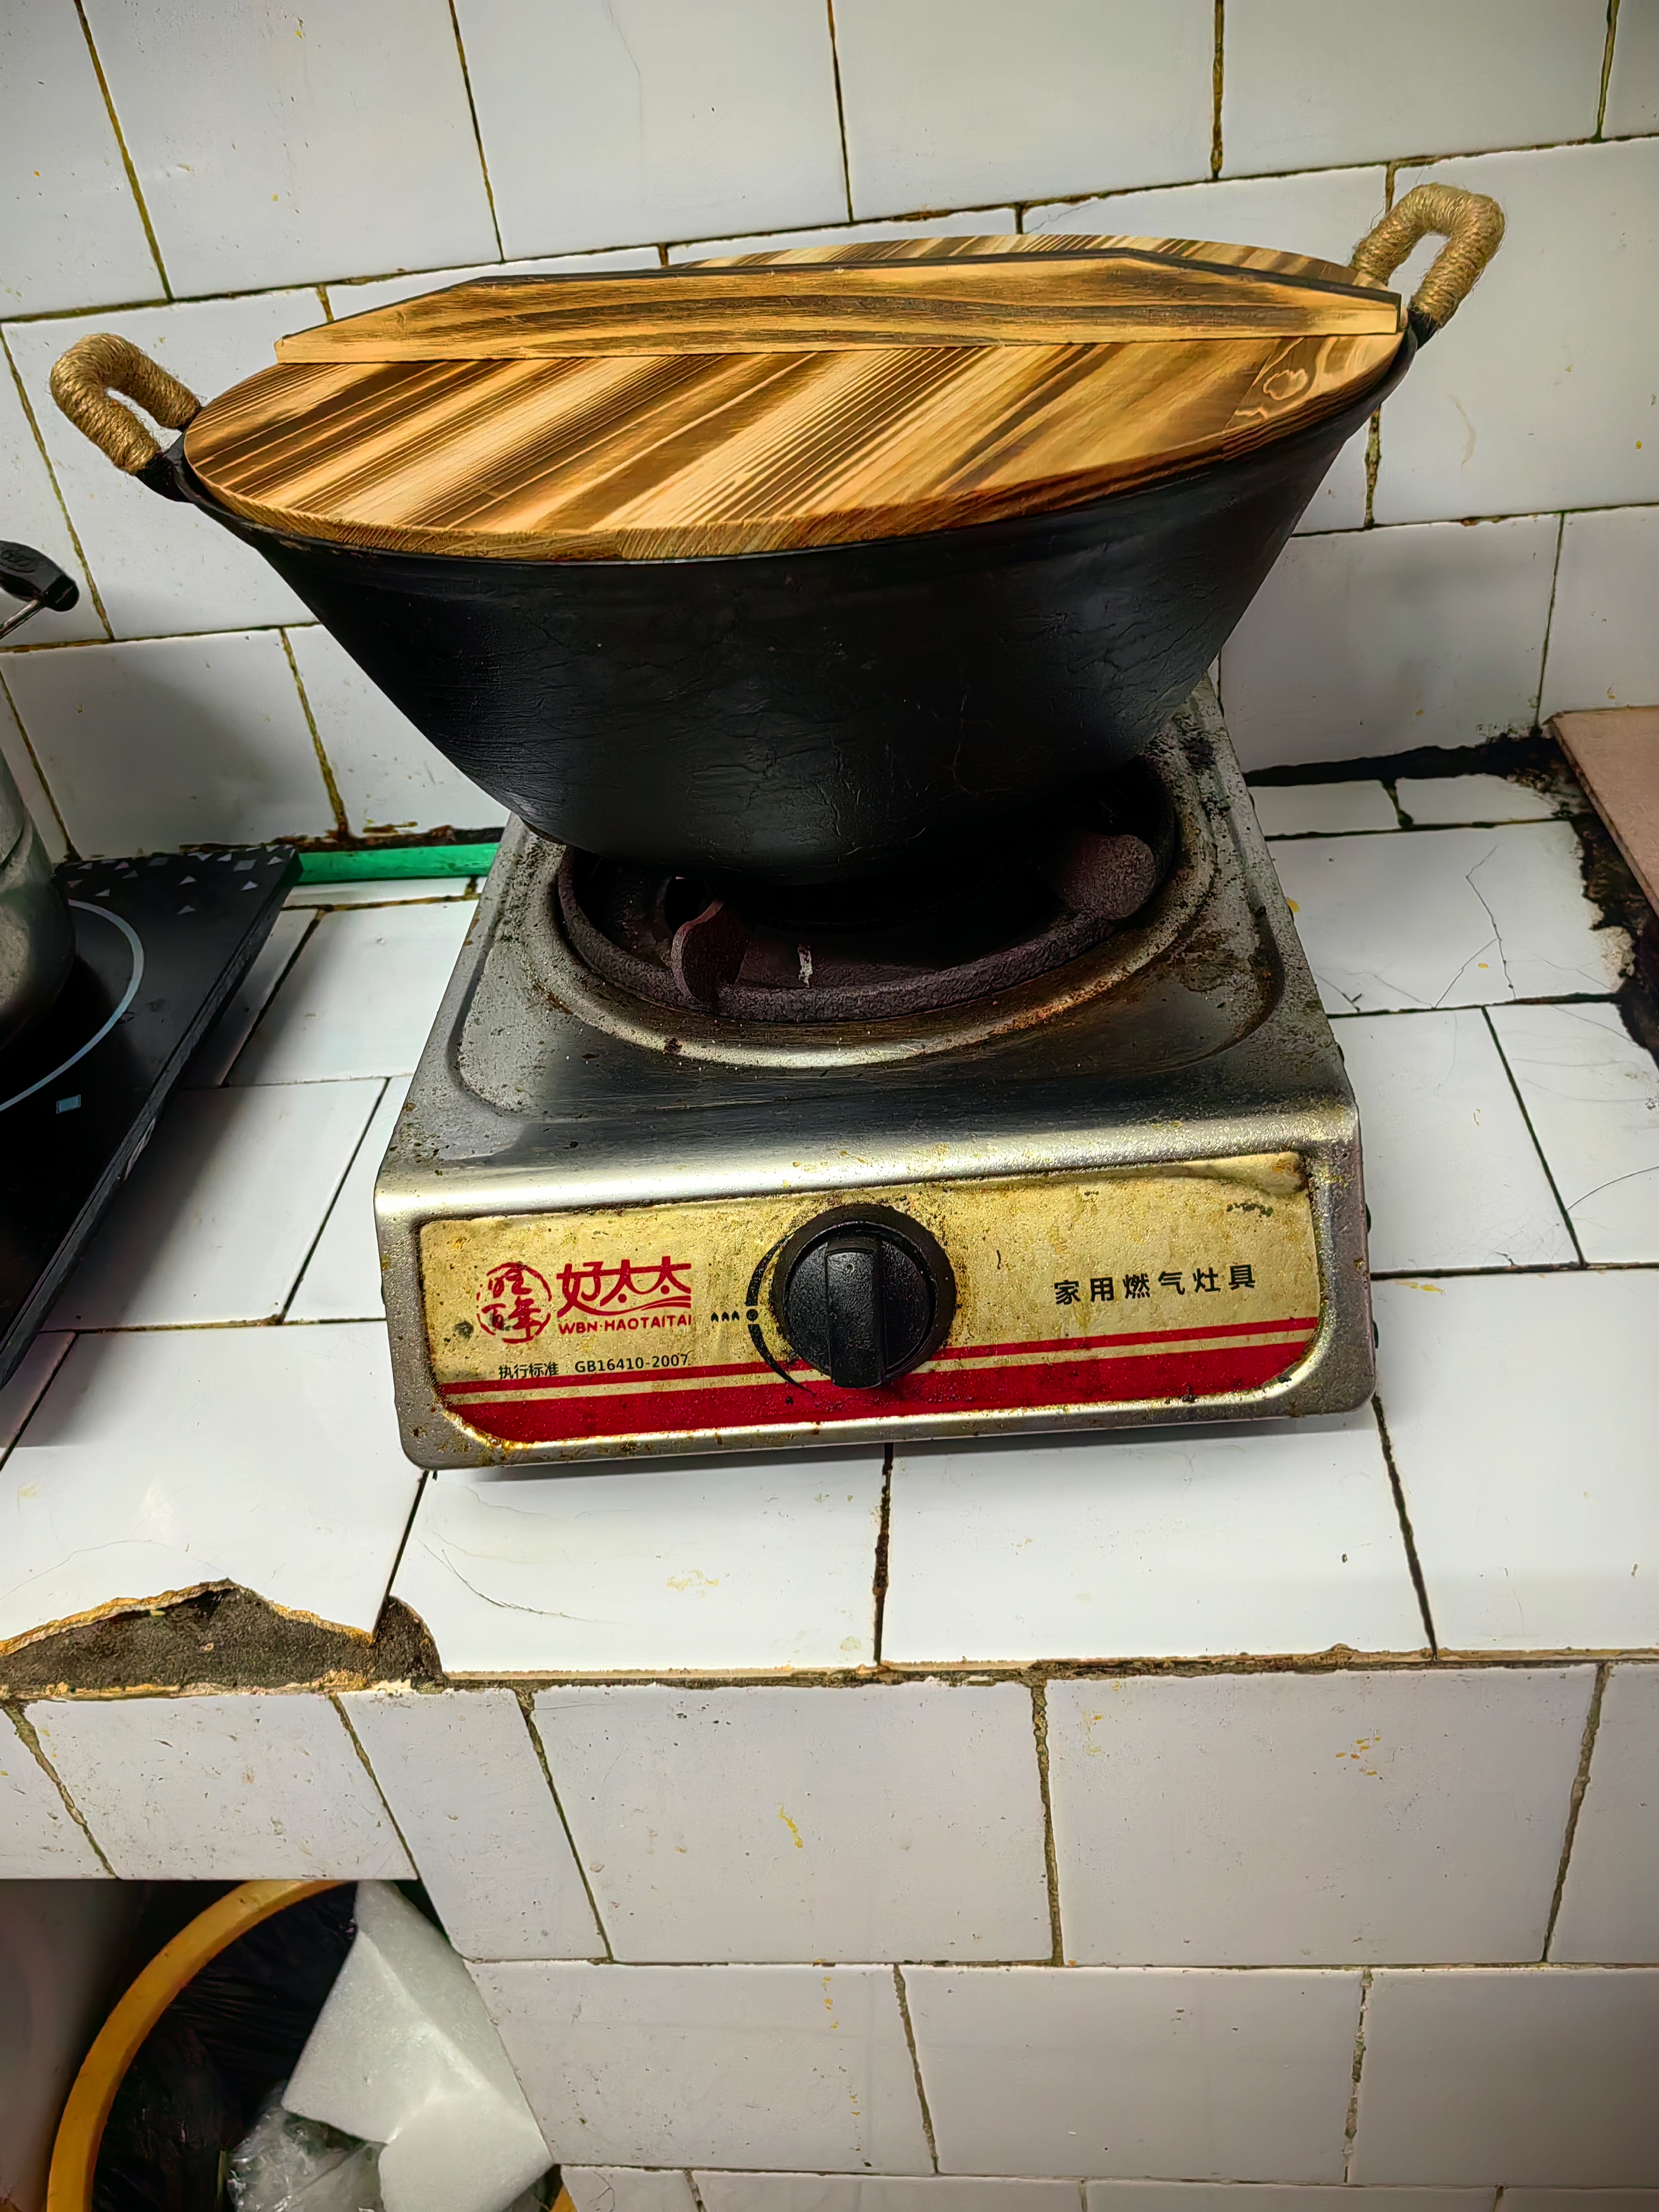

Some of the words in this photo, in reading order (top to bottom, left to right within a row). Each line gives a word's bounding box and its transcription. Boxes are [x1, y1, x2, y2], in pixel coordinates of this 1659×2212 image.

[556, 1256, 692, 1318] 好太太
[1054, 1264, 1256, 1305] 家用燃气灶具
[575, 1354, 689, 1373] GB16410-2007
